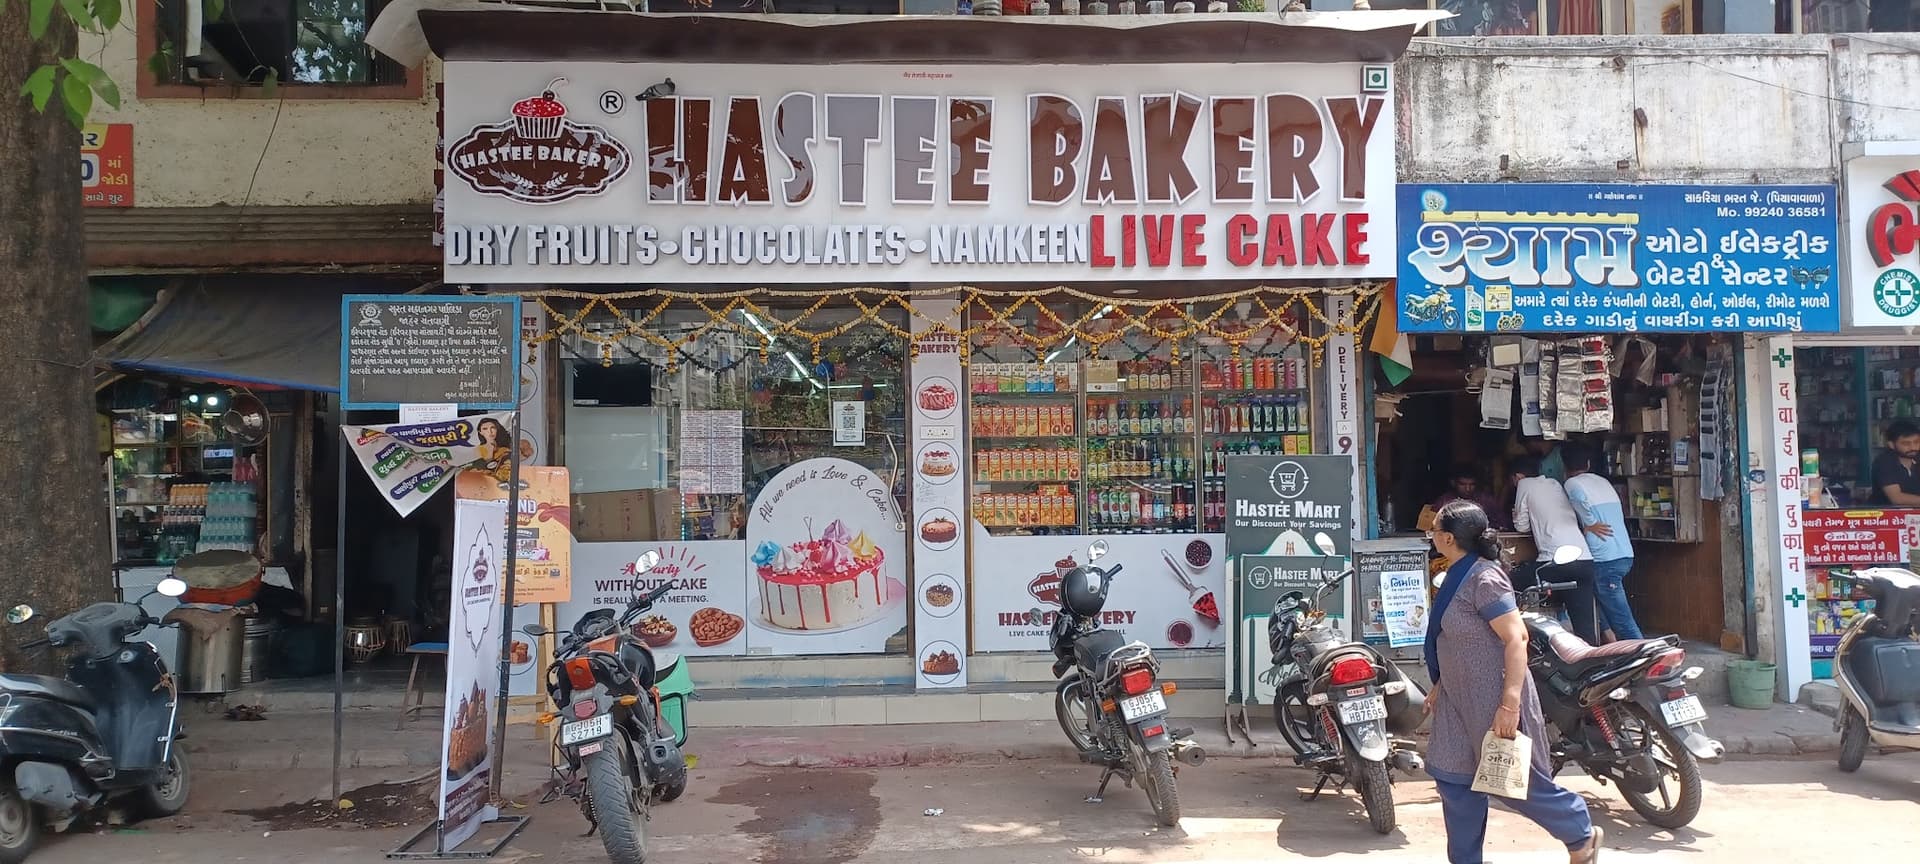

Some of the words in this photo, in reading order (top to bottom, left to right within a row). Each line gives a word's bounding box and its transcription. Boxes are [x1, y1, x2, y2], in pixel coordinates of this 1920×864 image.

[459, 145, 533, 169] HASTEE
[537, 145, 617, 170] BAKERY
[645, 92, 996, 207] HASTEE
[1026, 91, 1387, 206] BAKERY
[1724, 194, 1747, 204] ભરત
[1717, 208, 1741, 217] Mo.
[1745, 207, 1783, 217] 99240
[1788, 207, 1826, 217] 36581
[447, 223, 519, 266] DRY
[527, 223, 659, 266] FRUITS
[681, 223, 907, 266] CHOCOLATES
[929, 223, 1087, 265] NAMKEEN
[1090, 214, 1207, 268] LIVE
[1226, 213, 1370, 268] CAKE
[1646, 228, 1708, 254] ઓટો
[1408, 222, 1642, 287] શ્યામ
[1711, 253, 1725, 270] &
[1646, 260, 1710, 286] બેટરી
[1721, 261, 1788, 286] સેન્ટર
[1880, 271, 1917, 286] CHEMIST
[1514, 292, 1546, 308] અમારે
[1551, 290, 1569, 308] ત્યાં
[1574, 292, 1598, 308] દરેક
[1603, 290, 1647, 308] કંપનીની
[1765, 292, 1796, 308] રીમોટ
[1800, 292, 1829, 308] મળશે
[1878, 298, 1919, 316] DRUGGIST
[388, 304, 406, 316] સુરત
[1543, 310, 1577, 328] દરેક
[1585, 310, 1638, 332] ગાડીનું
[1711, 311, 1740, 328] કરી
[1747, 310, 1802, 332] આપીશું
[1338, 346, 1348, 420] DELIVERY
[760, 500, 774, 523] All
[772, 489, 785, 503] we
[785, 470, 806, 491] need
[810, 469, 818, 480] is
[821, 465, 849, 480] Love
[1235, 519, 1249, 528] Our
[1252, 519, 1286, 528] Discount
[1290, 520, 1306, 529] Your
[1309, 520, 1342, 530] Savings
[595, 579, 665, 592] WITHOUT
[671, 579, 708, 591] CAKE
[1032, 582, 1061, 594] HASTE
[593, 597, 601, 605] IS
[668, 595, 709, 604] MEETING.
